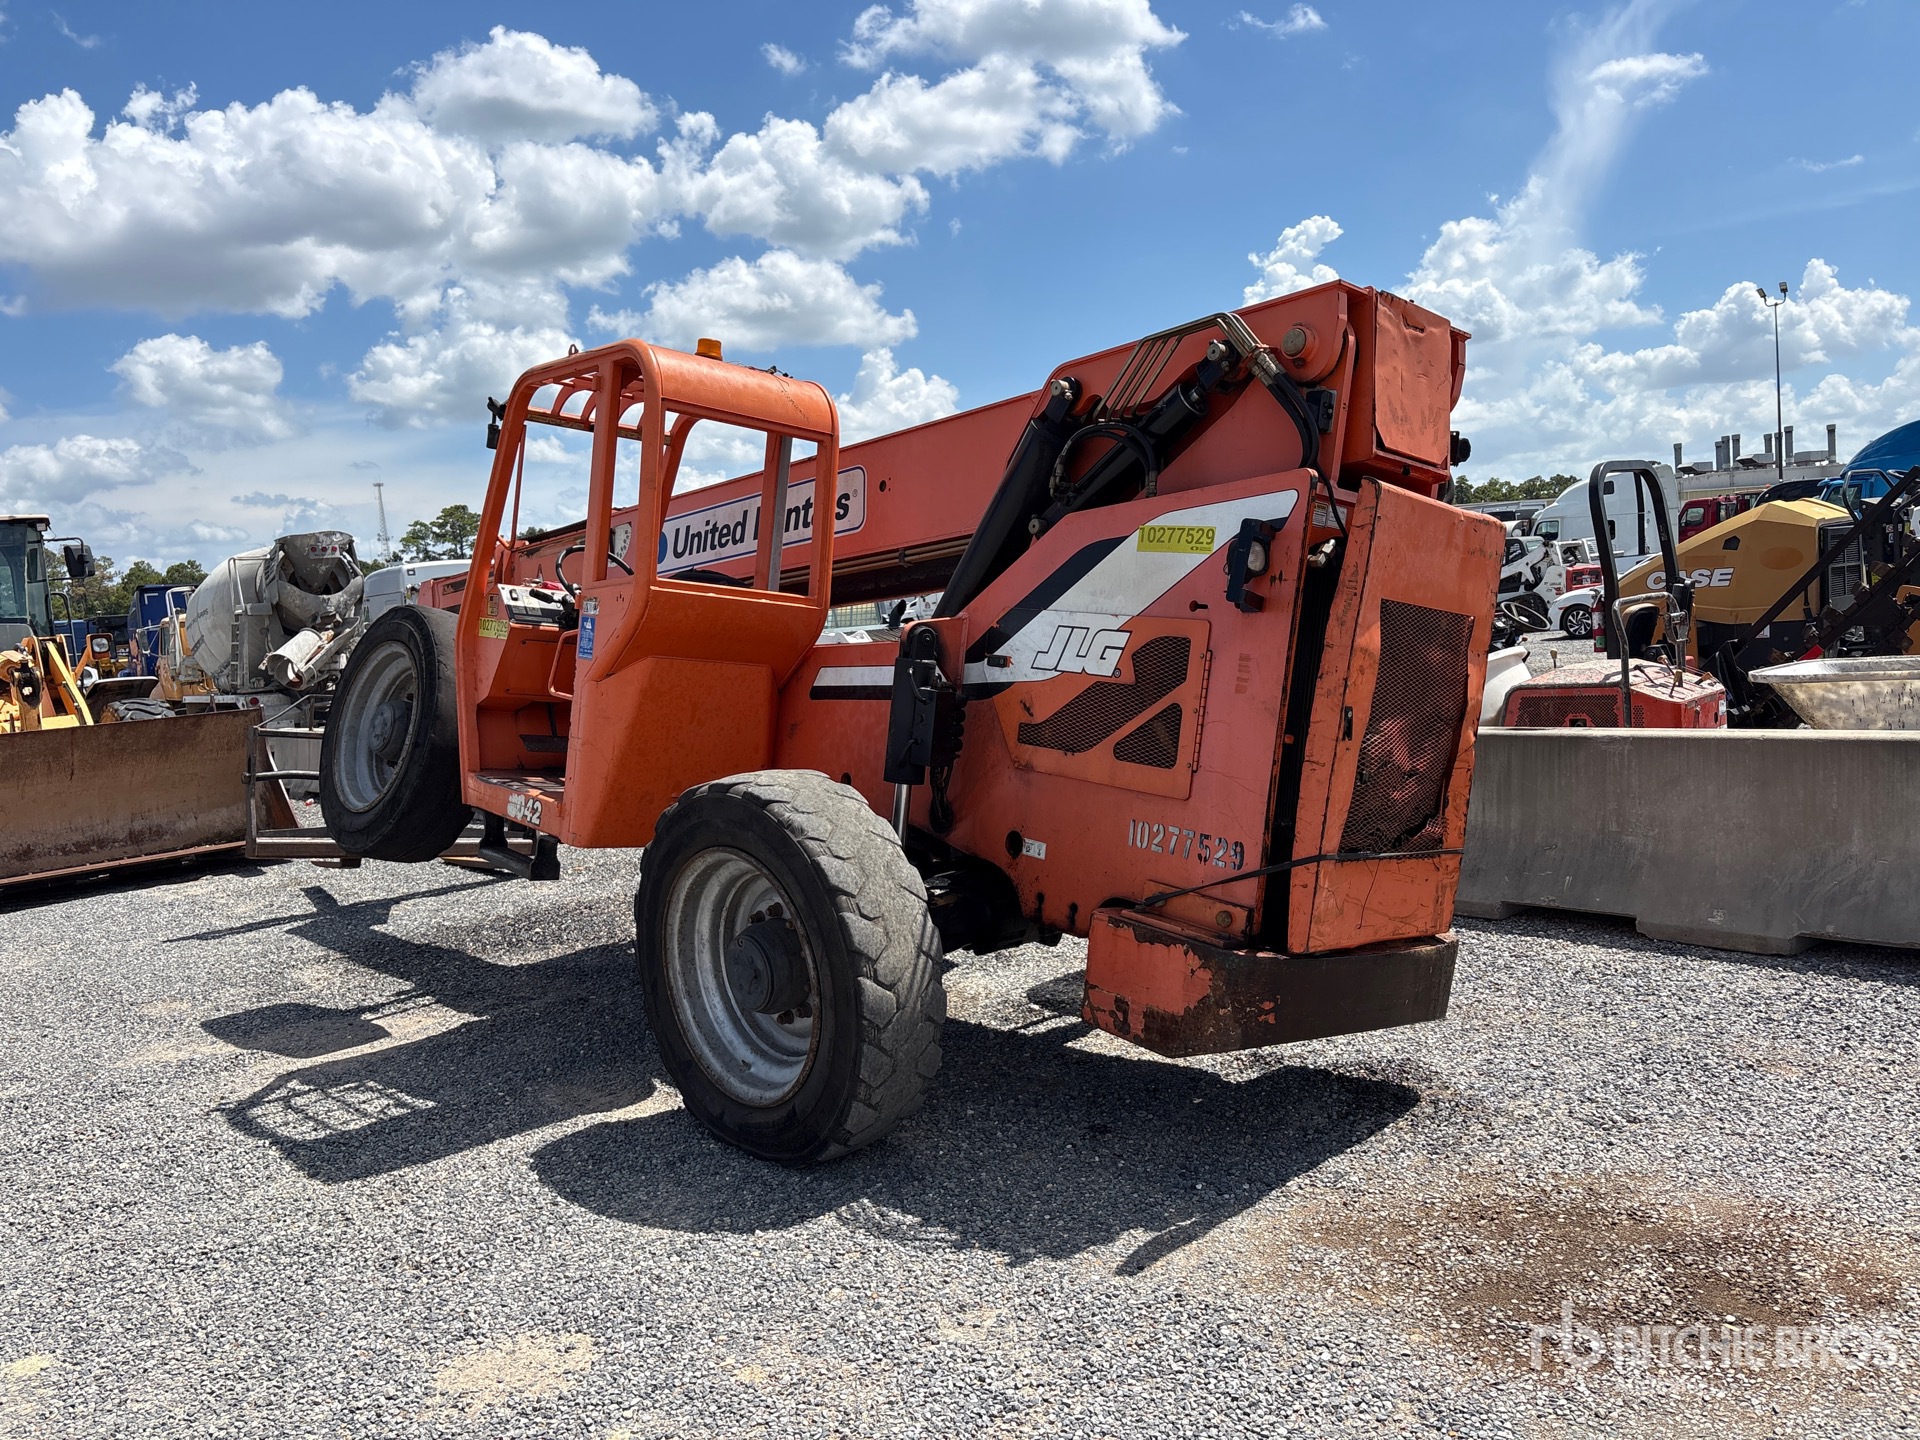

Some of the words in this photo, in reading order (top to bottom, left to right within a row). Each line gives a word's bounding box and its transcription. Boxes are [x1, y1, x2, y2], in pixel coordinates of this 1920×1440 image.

[673, 509, 749, 559] United
[1140, 527, 1215, 545] 10277529
[1646, 567, 1735, 590] CSE
[1031, 625, 1133, 678] JLG
[1128, 819, 1245, 871] 10277529
